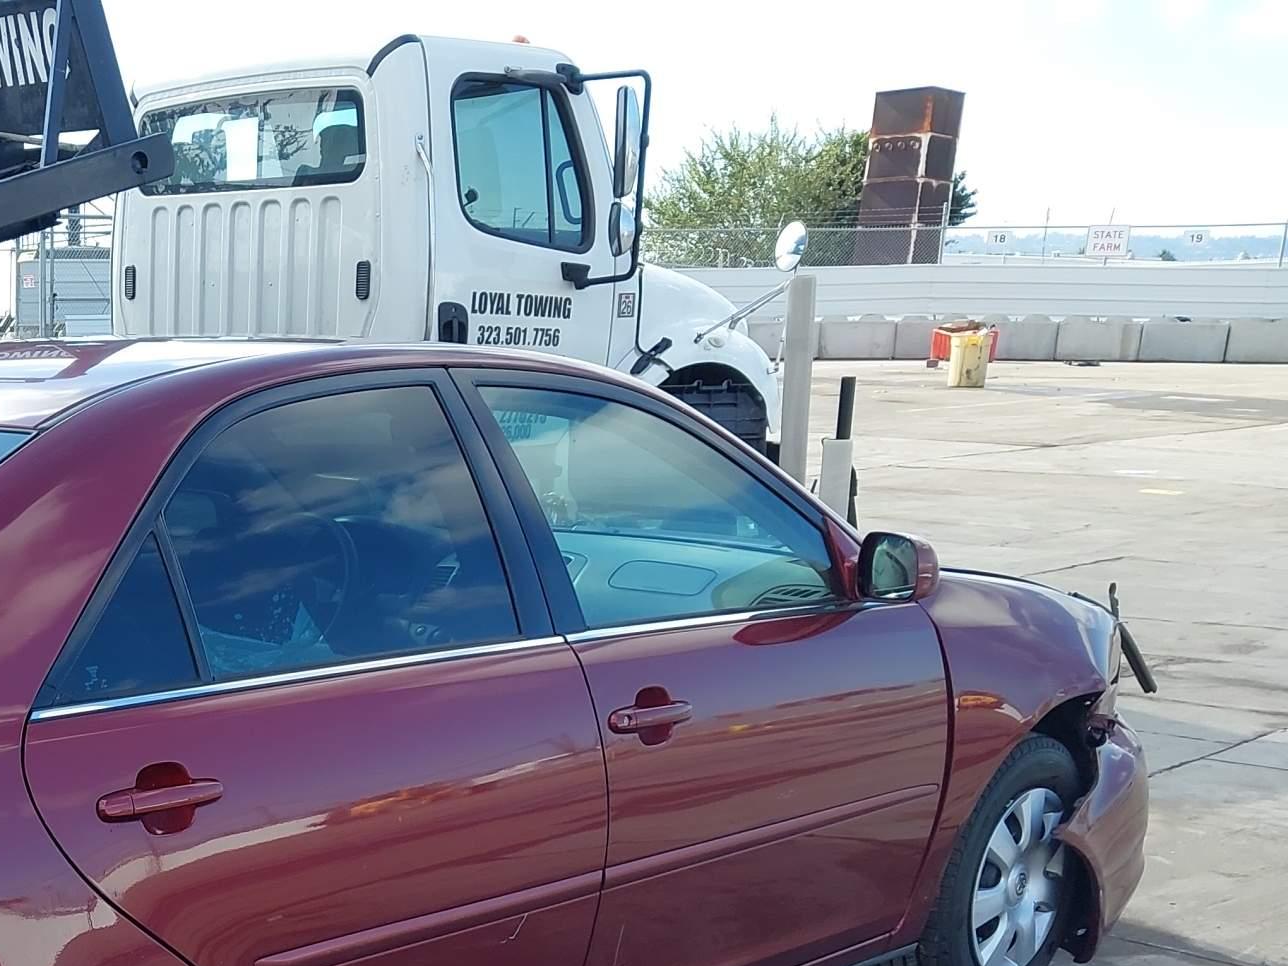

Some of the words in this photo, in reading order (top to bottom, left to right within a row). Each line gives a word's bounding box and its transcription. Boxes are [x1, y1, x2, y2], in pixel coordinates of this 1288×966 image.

[994, 234, 1006, 243] 18
[1094, 230, 1124, 239] STATE
[1191, 234, 1203, 243] 19
[1093, 243, 1121, 252] FARM
[471, 291, 511, 315] LOYAL
[516, 294, 572, 319] TOWING
[621, 300, 632, 314] 26
[477, 325, 560, 346] 323.501.7756
